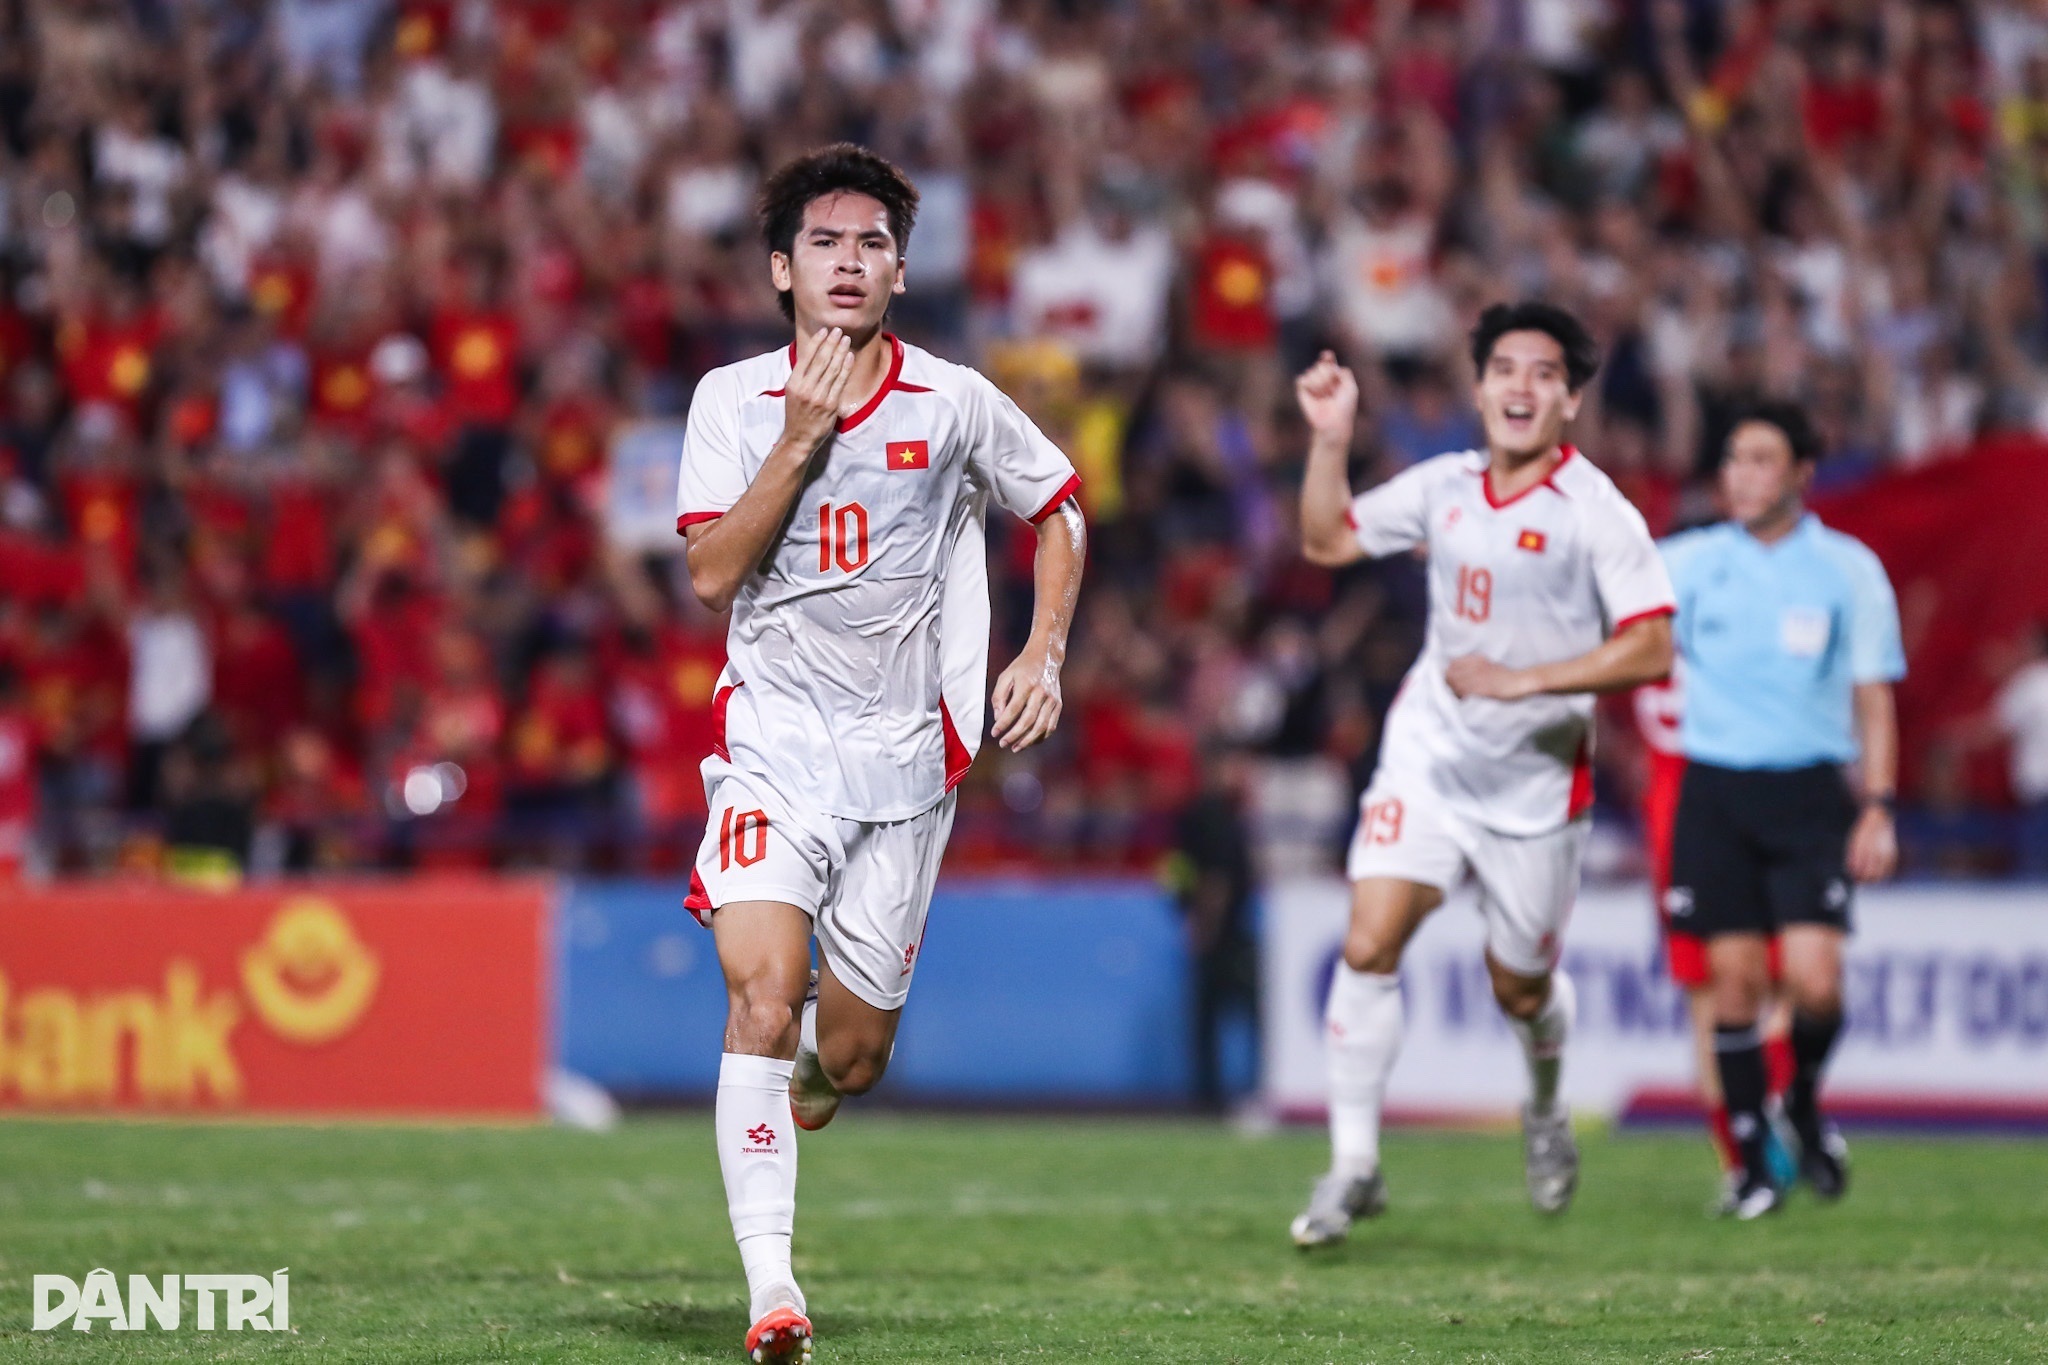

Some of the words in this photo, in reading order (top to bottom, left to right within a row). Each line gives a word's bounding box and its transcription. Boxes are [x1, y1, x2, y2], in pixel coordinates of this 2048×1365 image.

[818, 501, 869, 573] 10
[1455, 564, 1493, 624] 19
[719, 805, 769, 873] 10
[1361, 797, 1405, 847] 19
